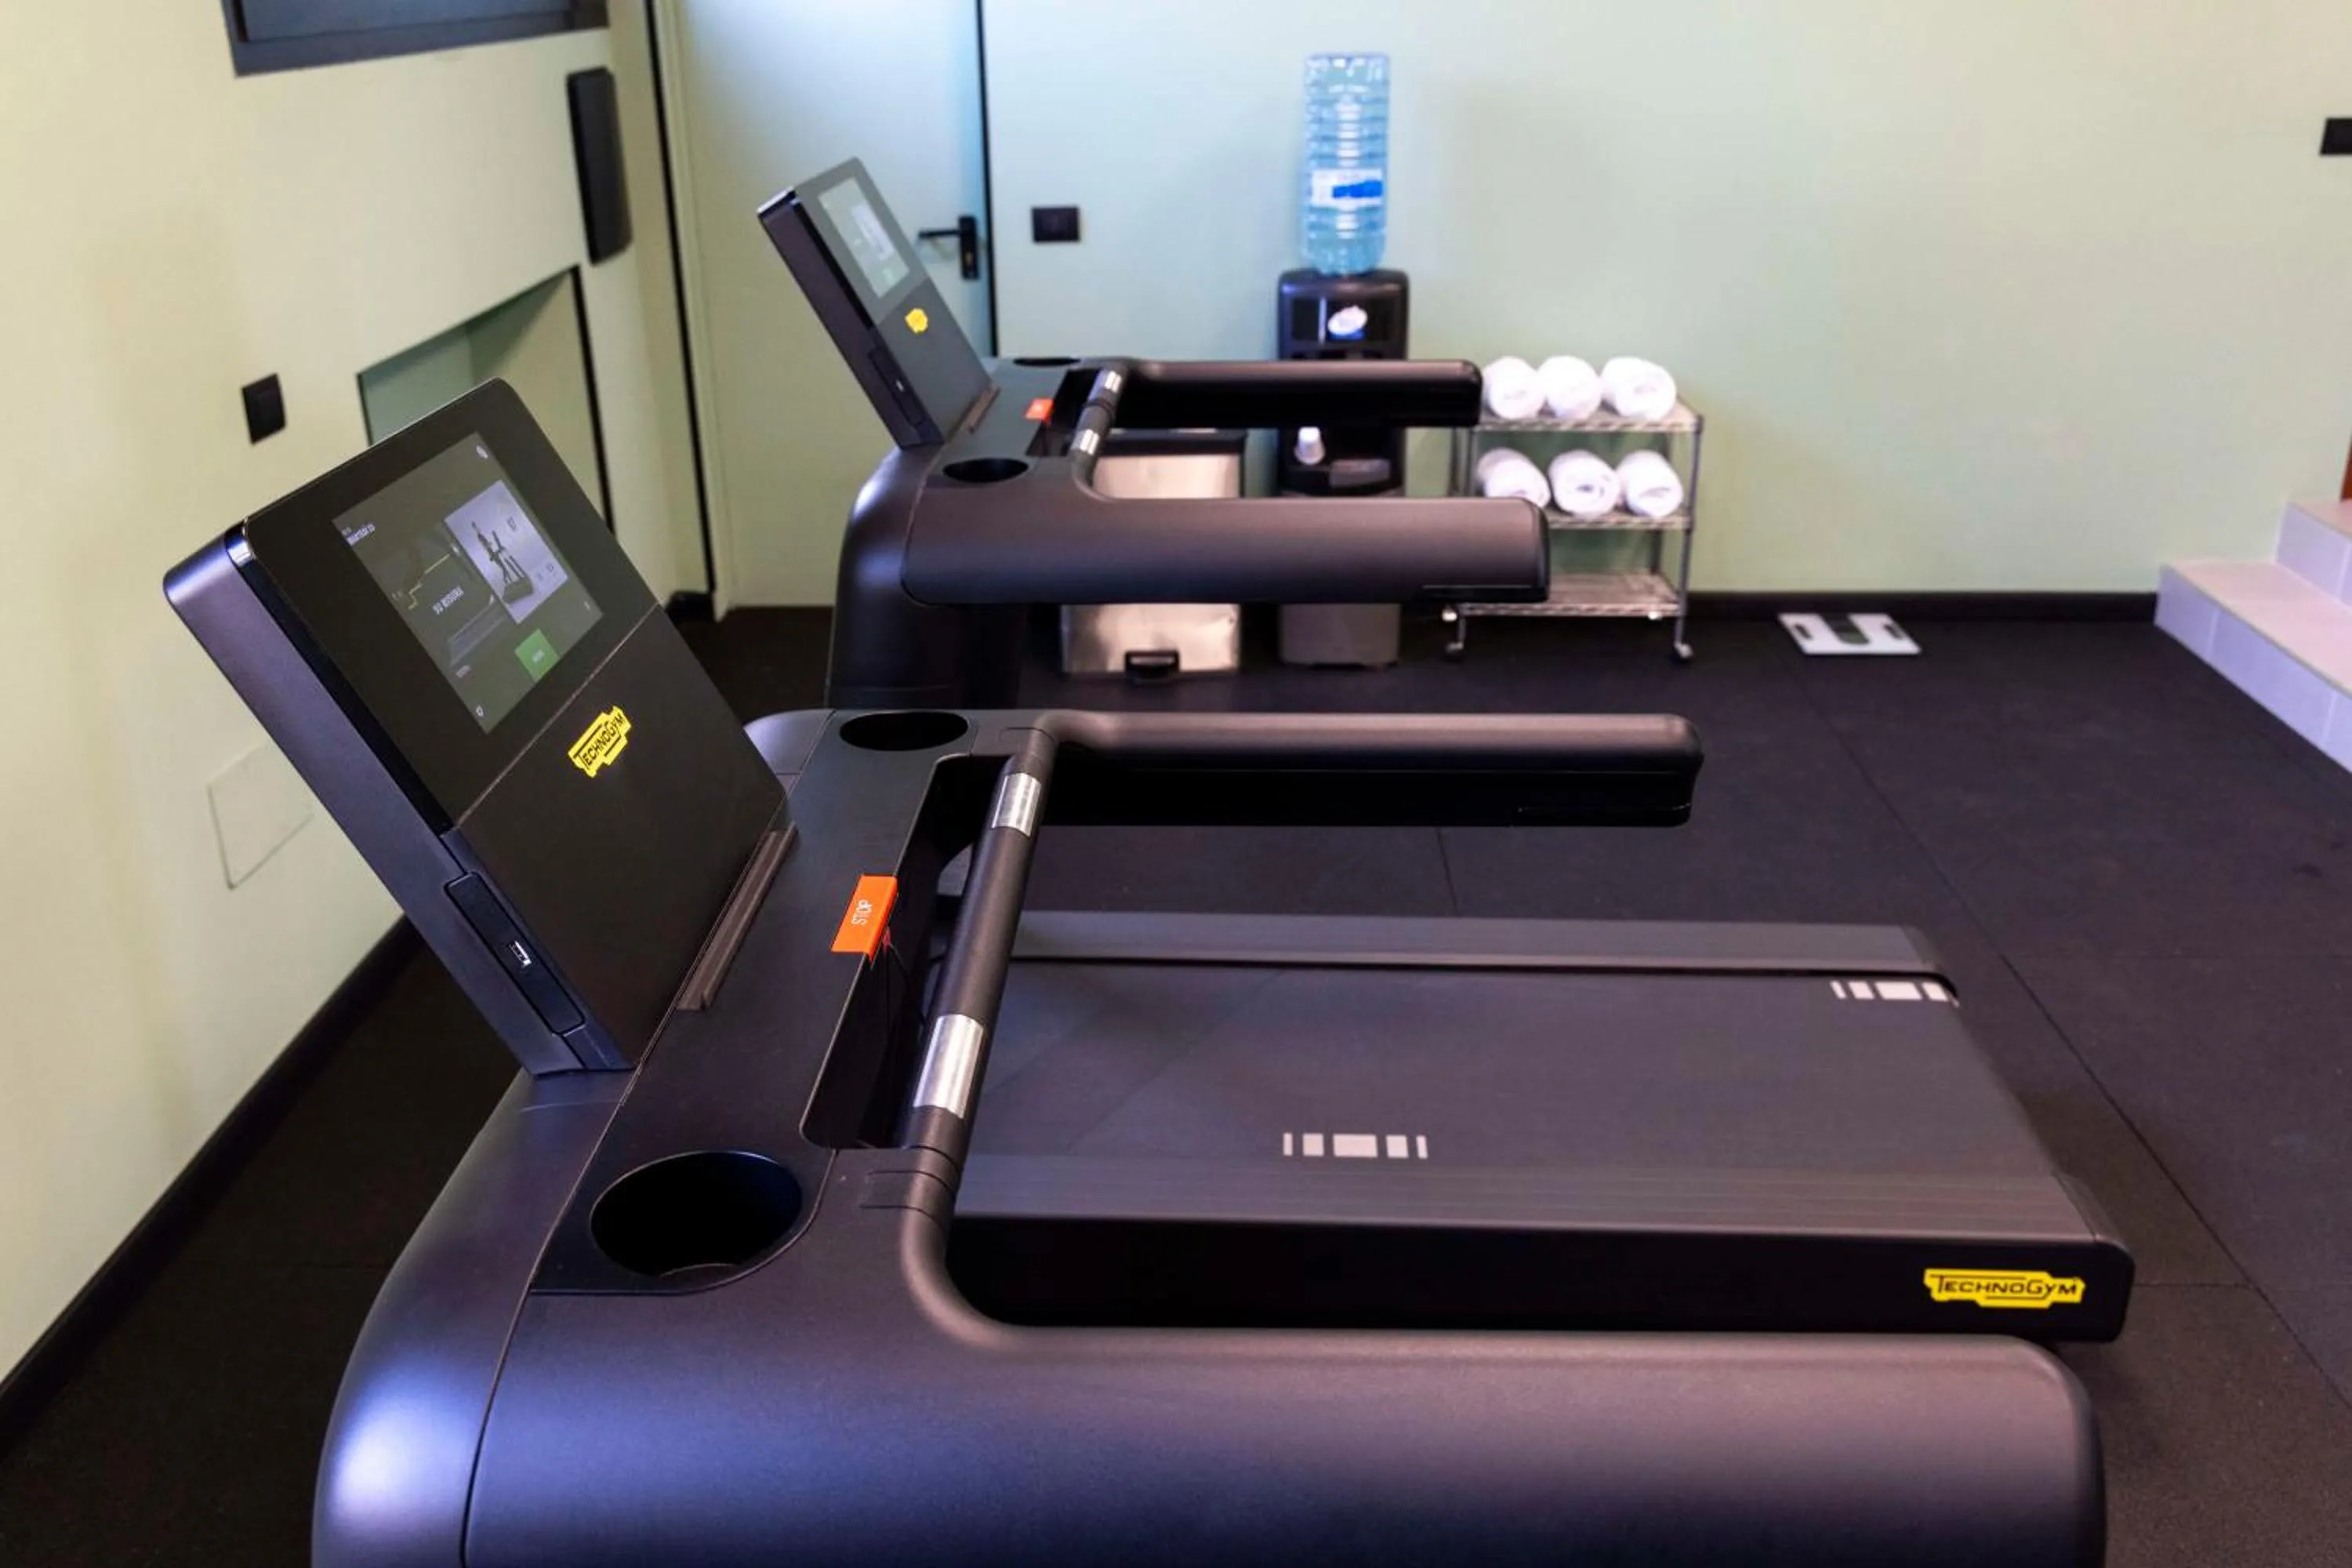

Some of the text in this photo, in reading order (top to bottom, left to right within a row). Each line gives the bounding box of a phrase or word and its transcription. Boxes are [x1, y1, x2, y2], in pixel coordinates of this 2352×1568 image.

[572, 712, 626, 771] TECHNOGYM
[851, 898, 873, 926] STOP
[1930, 1273, 2078, 1301] TECHNOGYM
